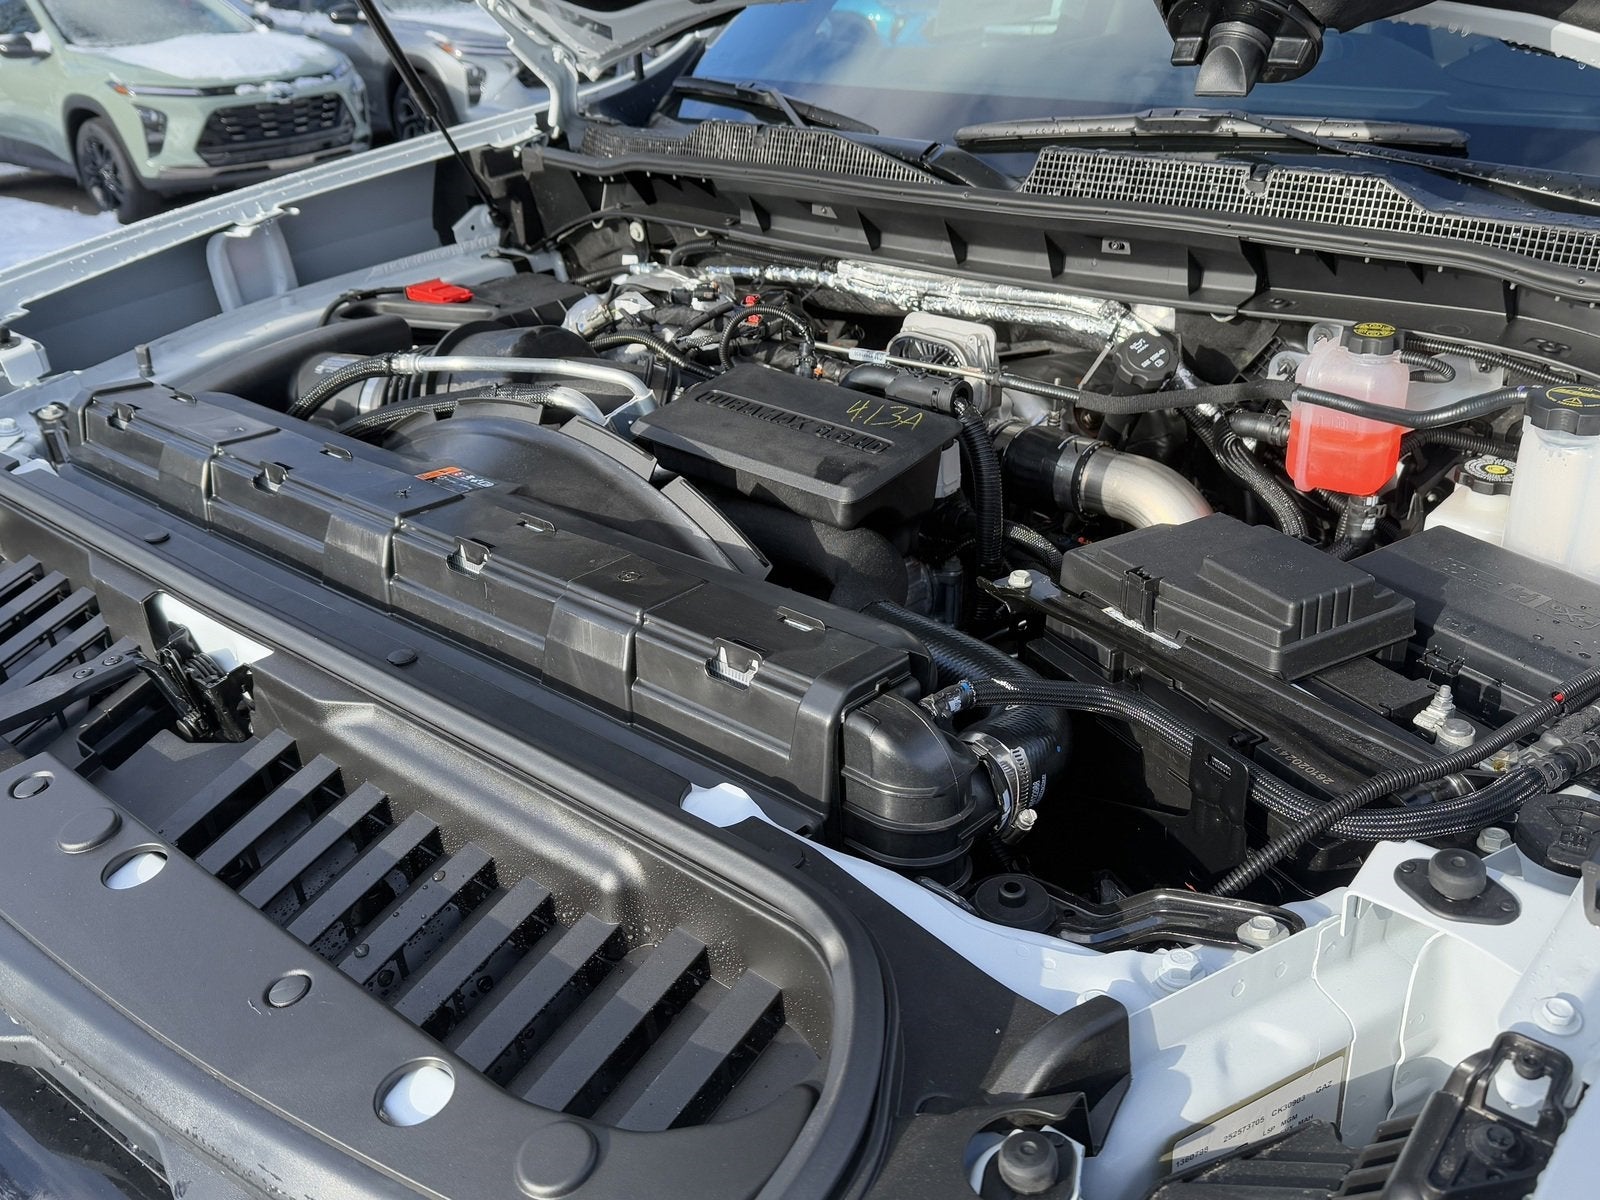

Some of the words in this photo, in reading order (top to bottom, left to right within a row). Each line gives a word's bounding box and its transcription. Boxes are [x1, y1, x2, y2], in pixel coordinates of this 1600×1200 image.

[702, 392, 813, 431] DURAMAX
[1271, 1095, 1307, 1117] CK30903
[1315, 1080, 1333, 1094] GAZ
